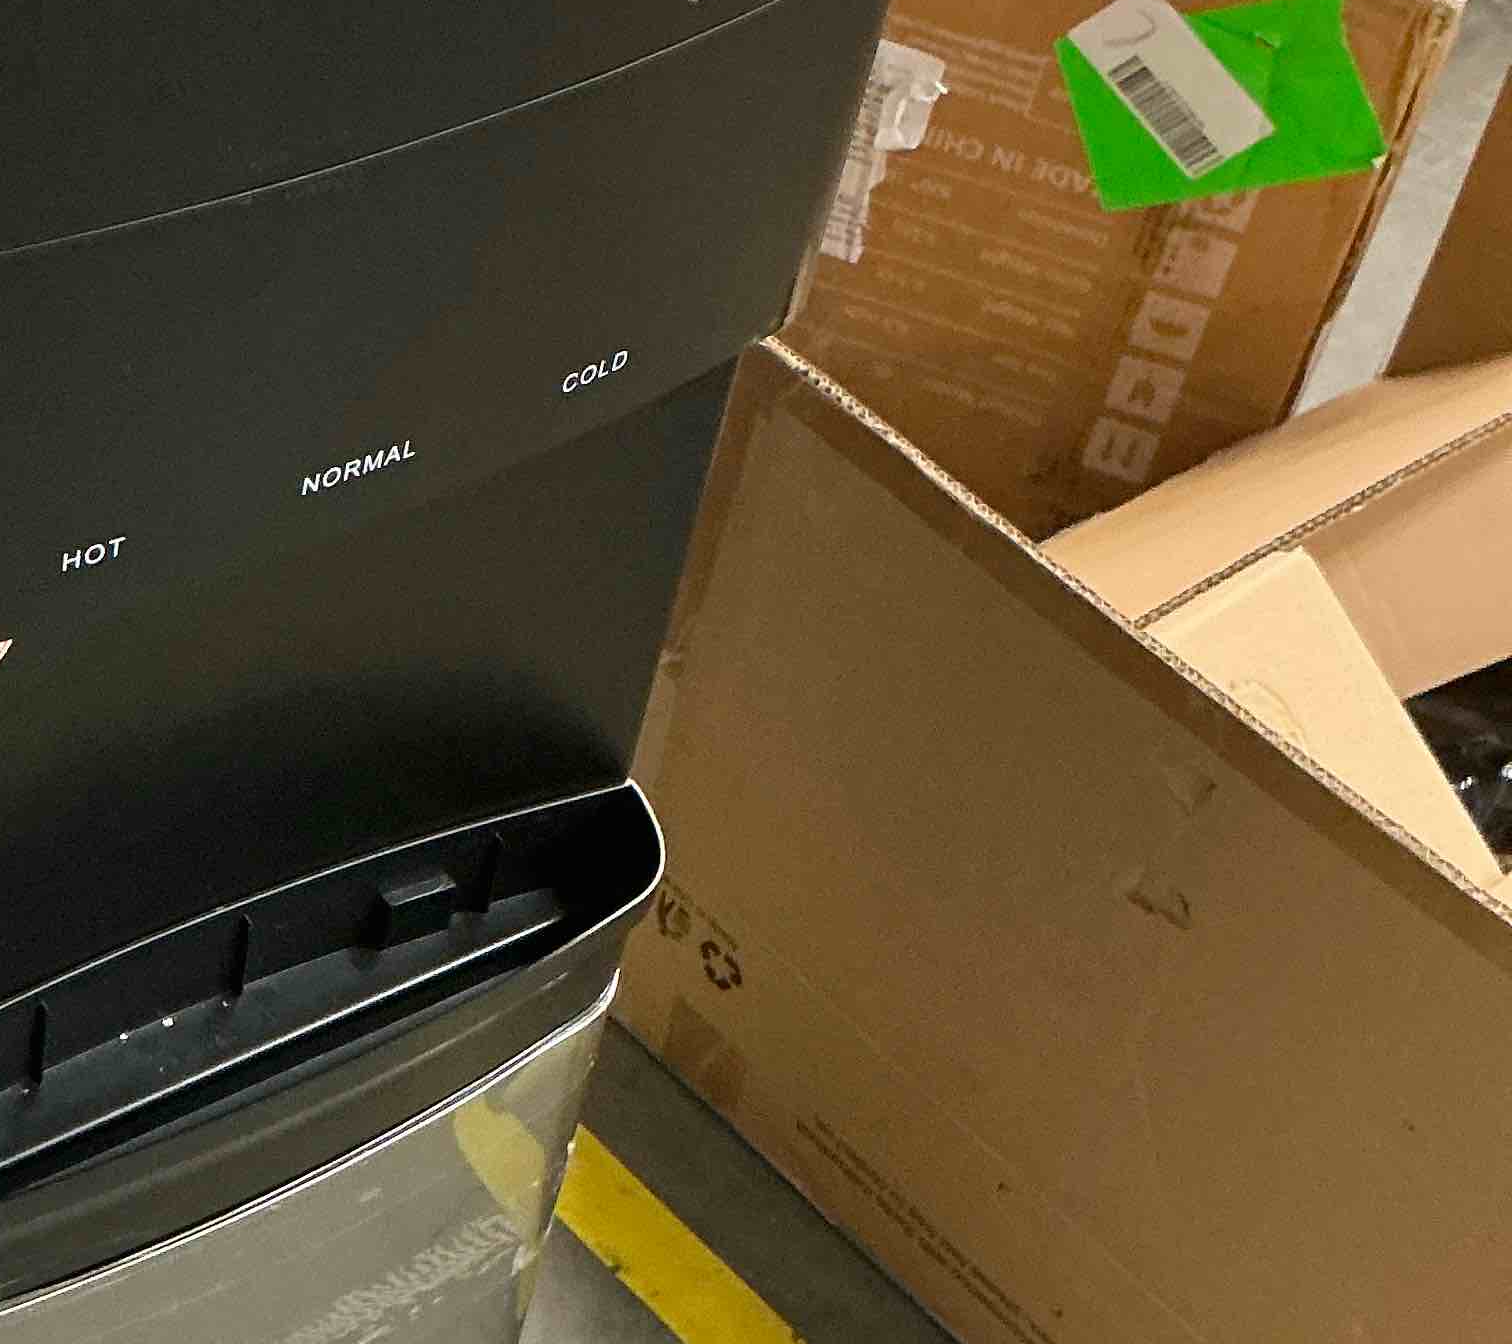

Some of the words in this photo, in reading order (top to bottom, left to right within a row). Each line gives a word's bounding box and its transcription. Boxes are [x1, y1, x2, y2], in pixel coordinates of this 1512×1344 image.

[562, 350, 629, 393] COLD
[301, 439, 416, 496] NORMAL
[61, 536, 127, 573] HOT
